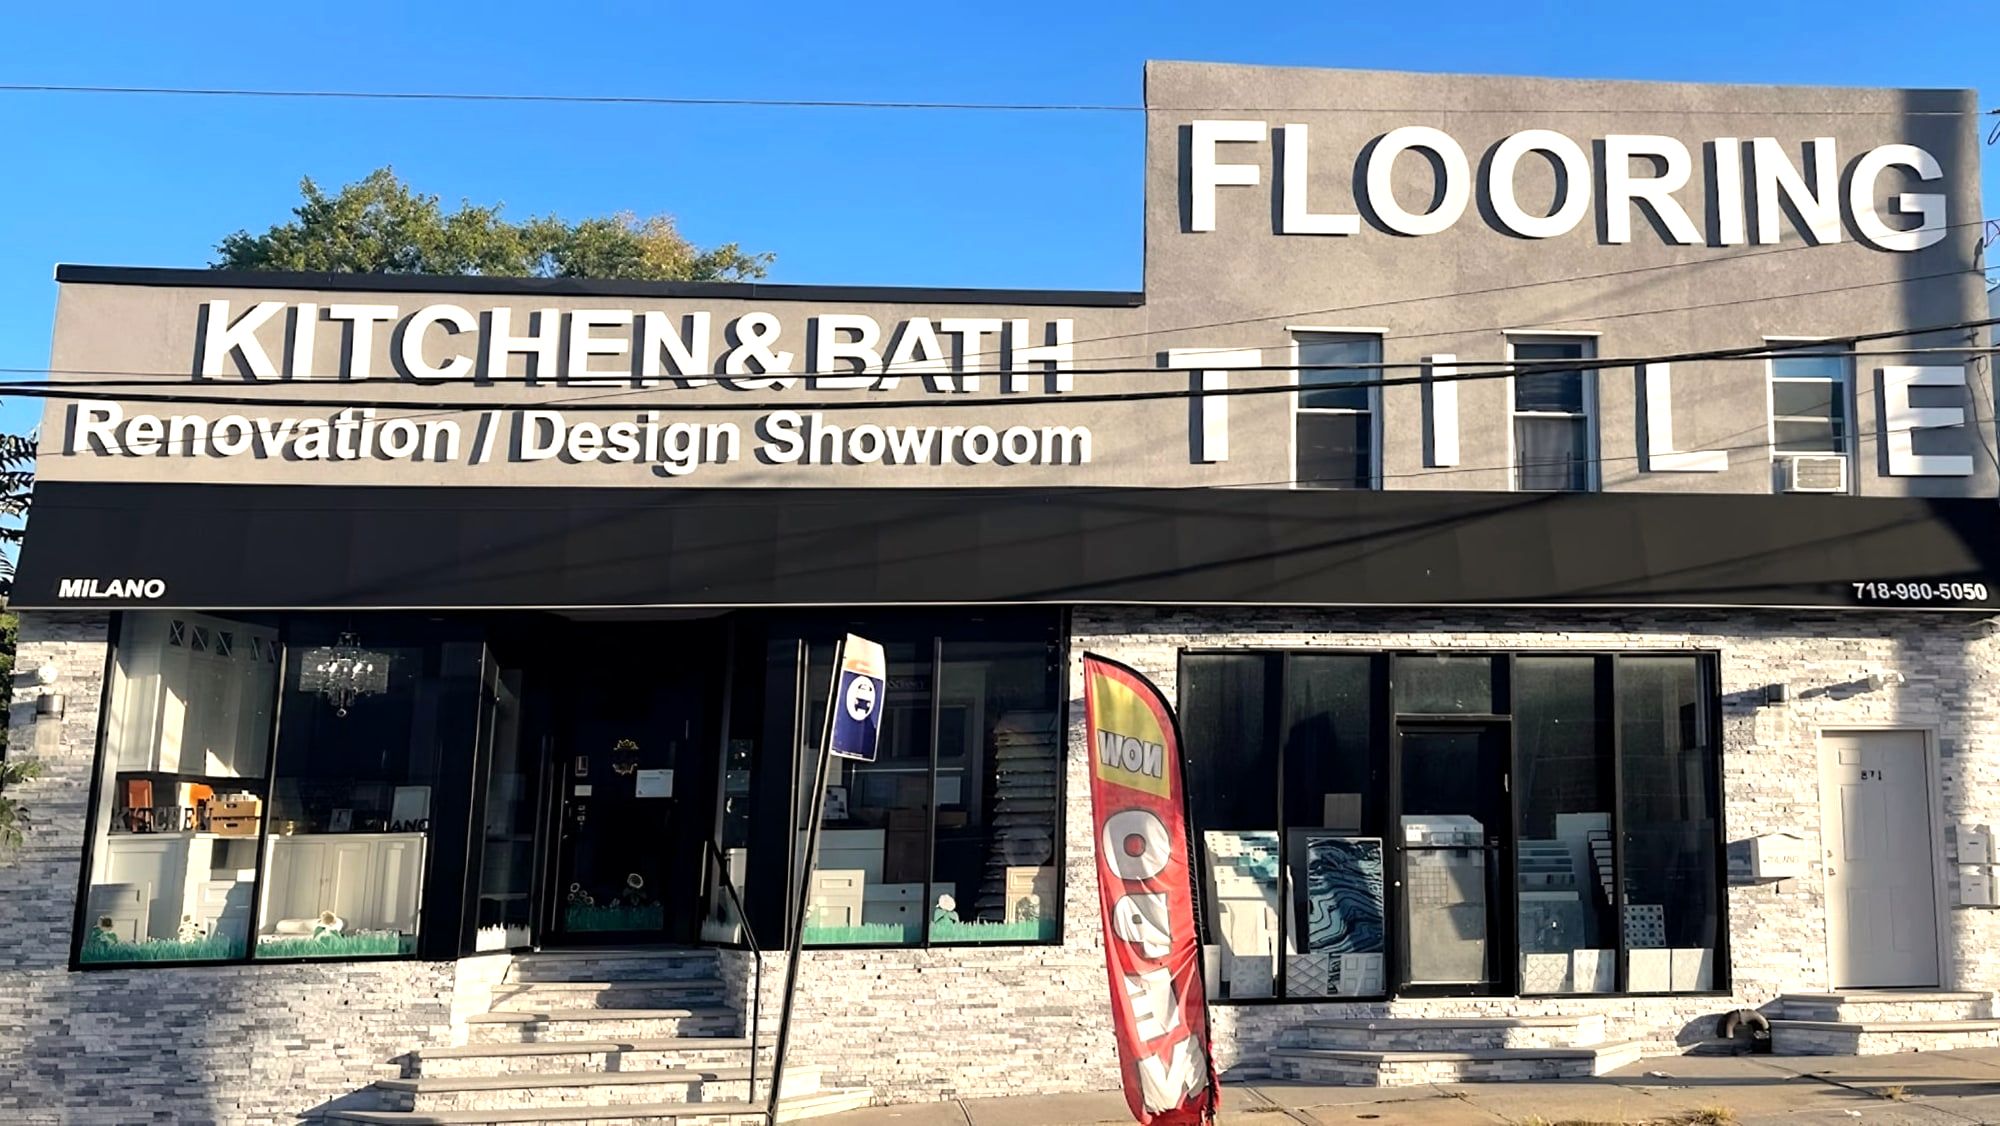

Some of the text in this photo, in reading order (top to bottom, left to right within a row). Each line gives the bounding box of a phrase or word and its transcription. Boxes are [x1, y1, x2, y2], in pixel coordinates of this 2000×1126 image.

[1191, 118, 1947, 252] FLOORING
[72, 398, 1093, 476] Renovation / Design Showroom
[1168, 347, 1973, 476] TILE
[58, 578, 166, 598] MILANO
[1852, 582, 1988, 601] 718-980-5050
